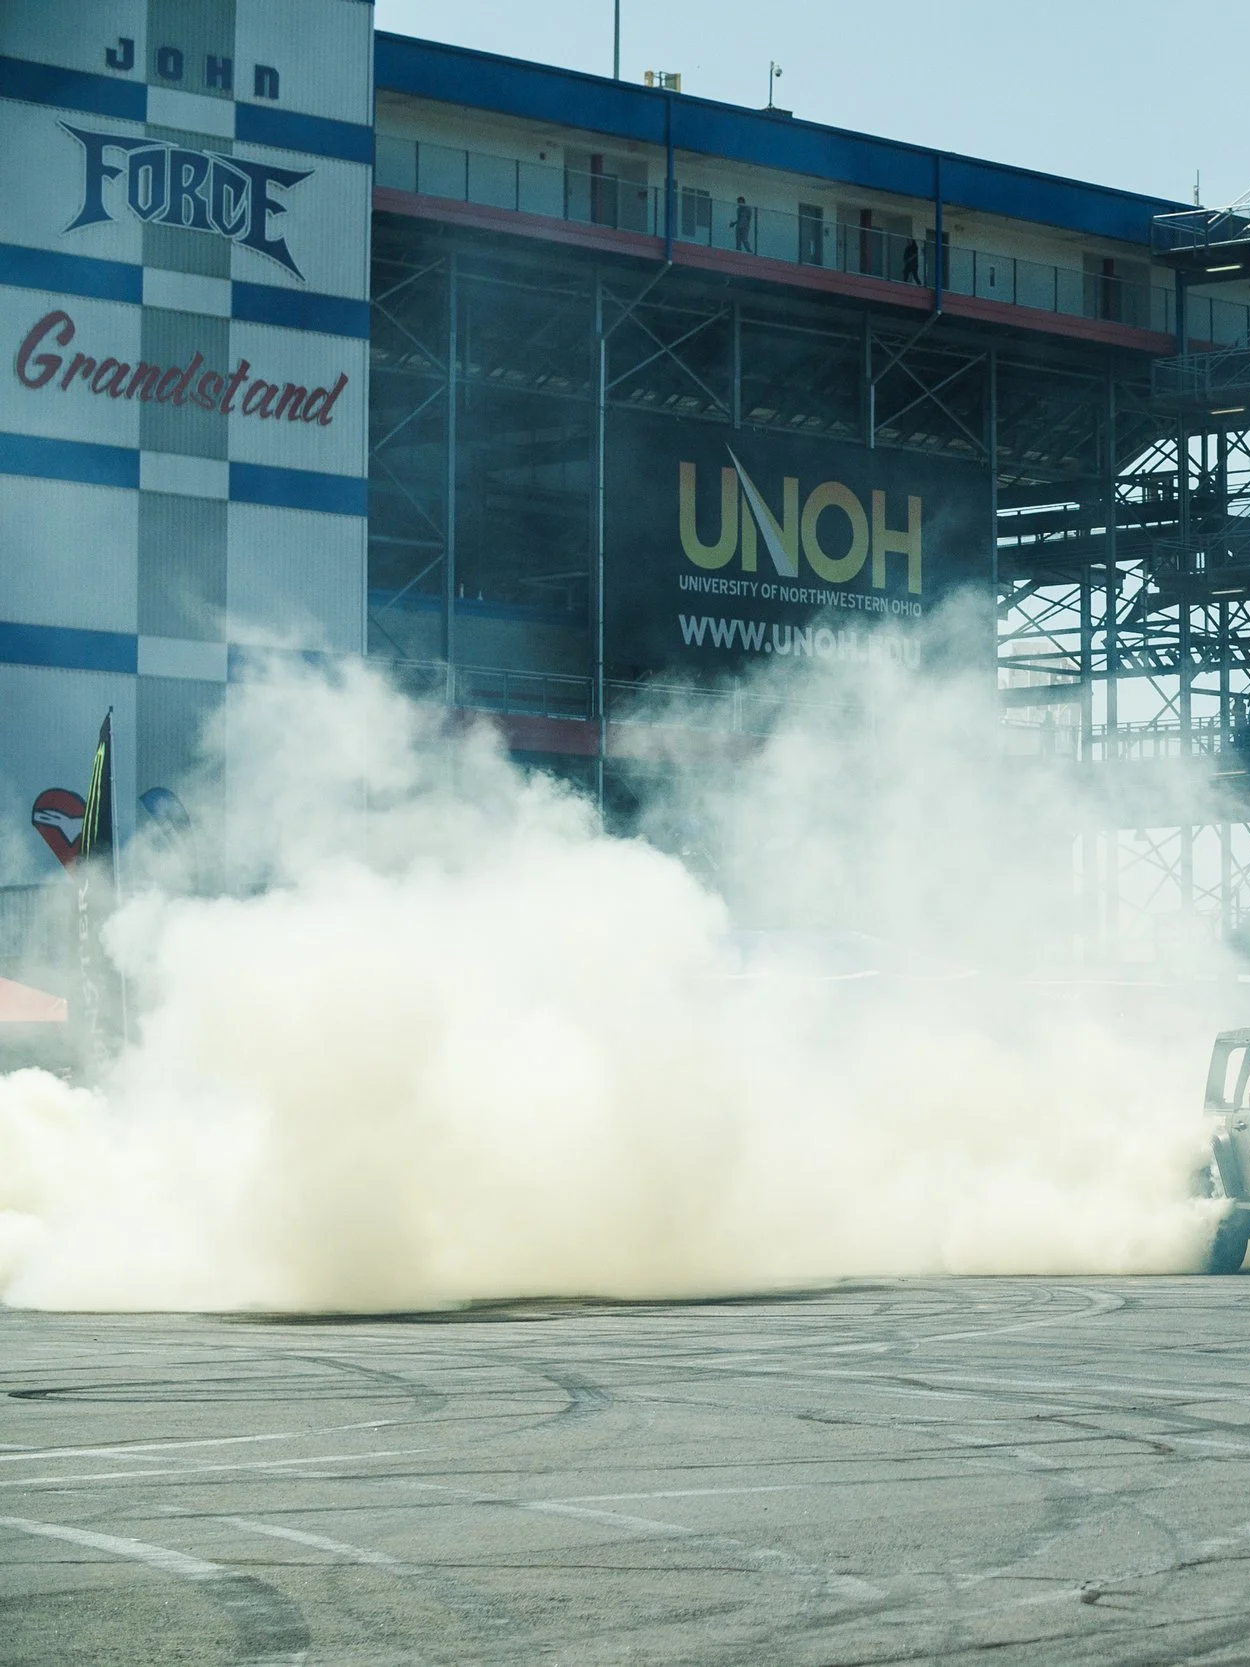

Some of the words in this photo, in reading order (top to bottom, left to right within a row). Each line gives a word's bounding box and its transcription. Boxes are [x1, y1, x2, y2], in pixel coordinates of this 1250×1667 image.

[106, 37, 279, 100] JOHN
[55, 119, 317, 284] FORCE
[16, 310, 349, 426] Grandstand
[679, 442, 922, 595] UNOH
[679, 574, 759, 598] UNIVERSITY
[761, 583, 778, 600] OF
[779, 586, 890, 613] NORTHWESTERN
[892, 600, 922, 617] OHIO
